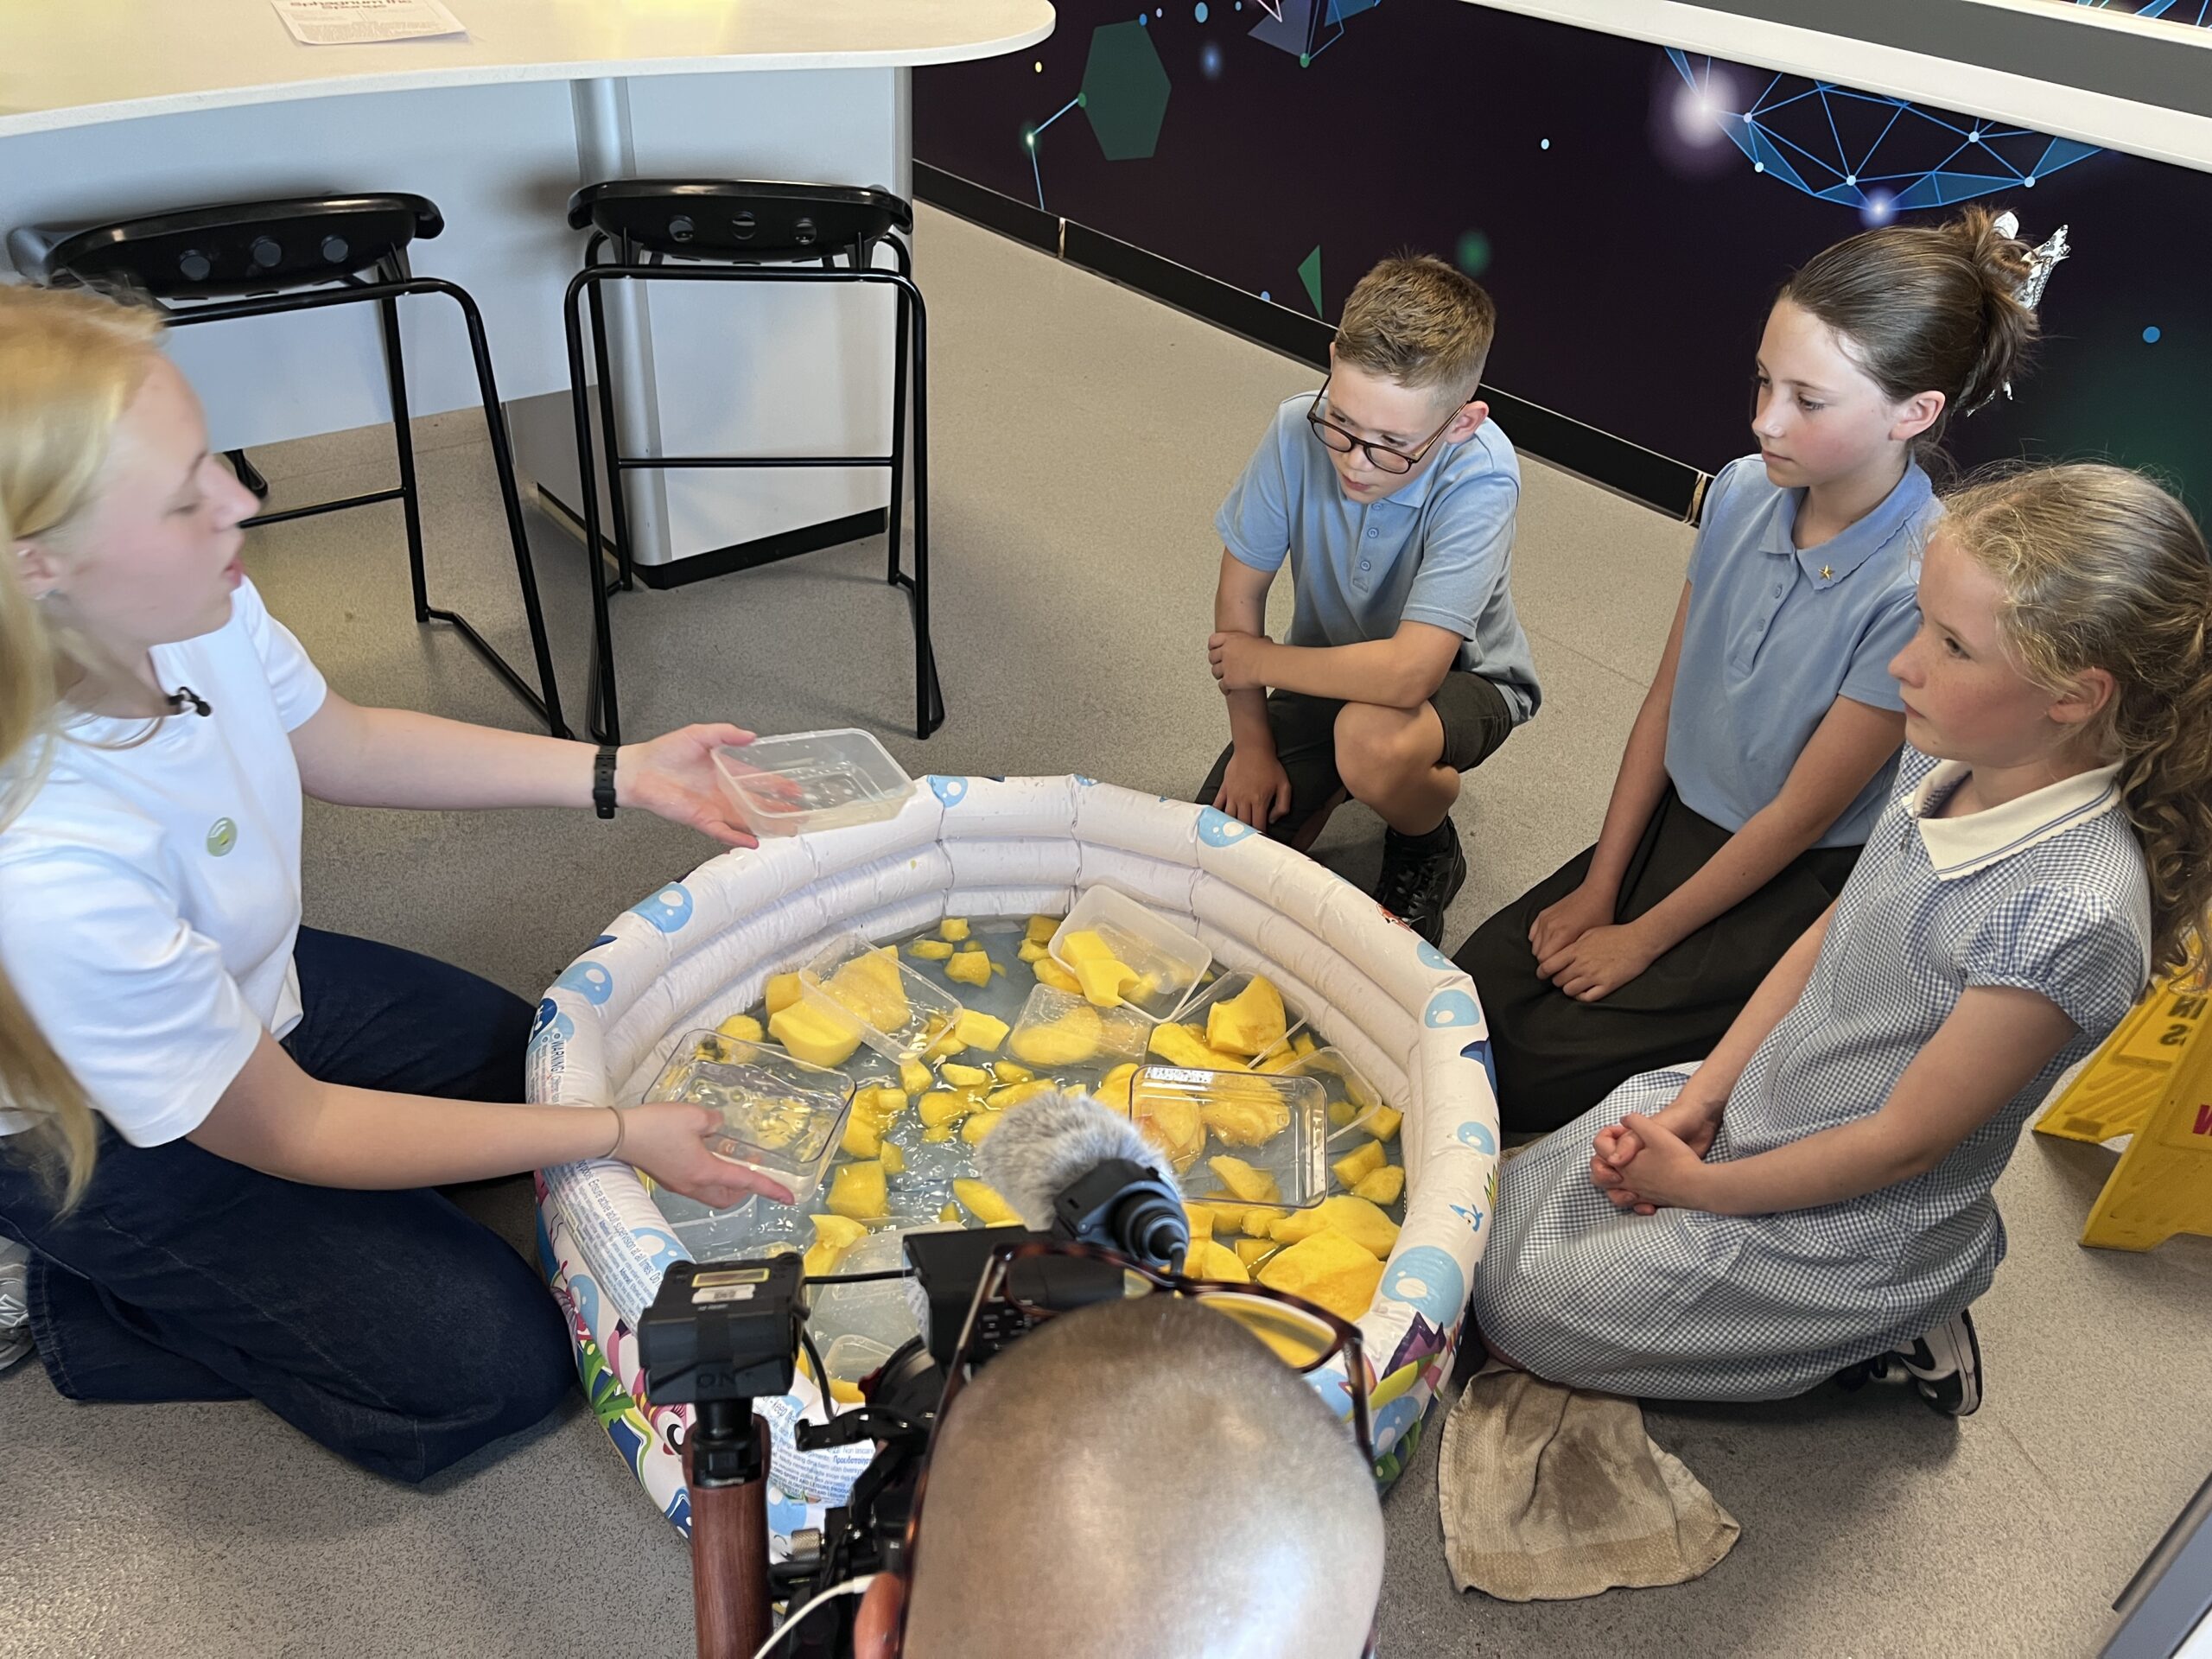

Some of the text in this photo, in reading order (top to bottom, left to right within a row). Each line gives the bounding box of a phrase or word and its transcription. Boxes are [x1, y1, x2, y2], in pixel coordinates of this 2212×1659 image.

[550, 1040, 564, 1073] WARNING!
[588, 1179, 604, 1198] Ensure
[598, 1195, 612, 1212] active
[605, 1211, 620, 1227] adult
[612, 1221, 638, 1251] supervision
